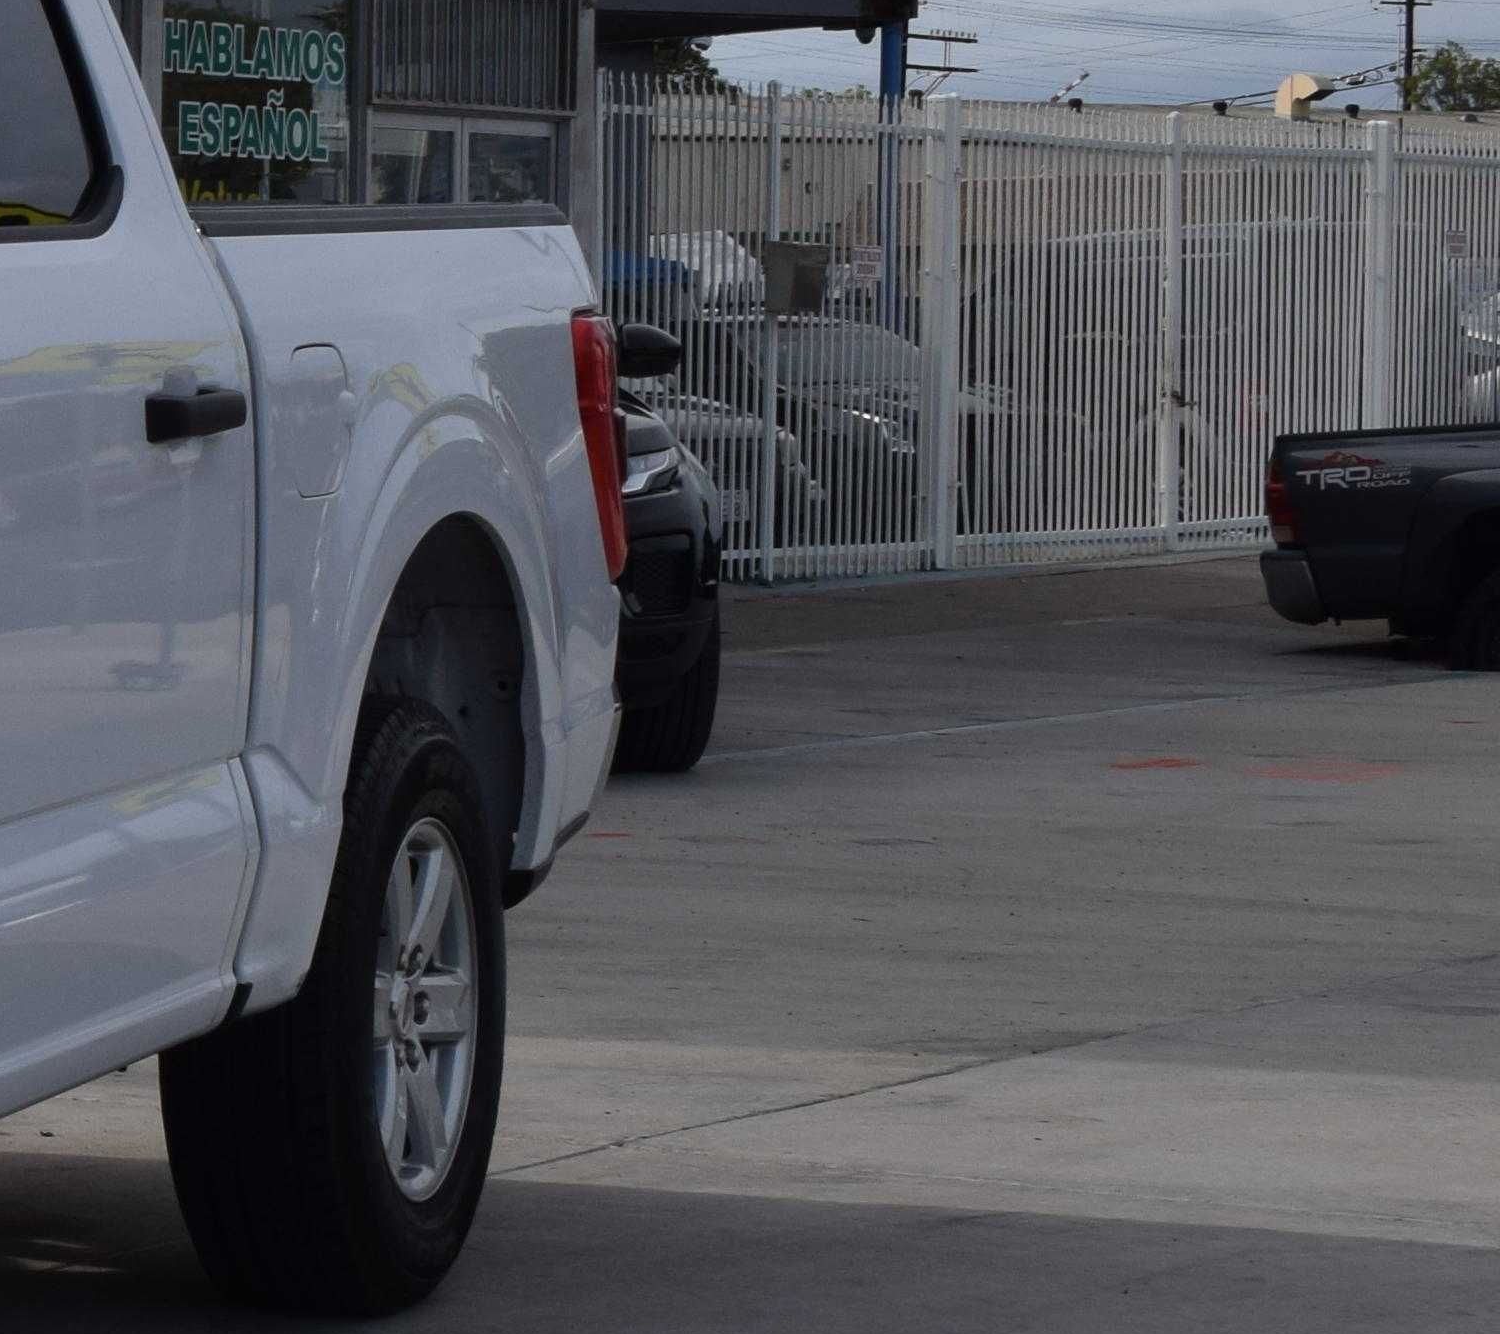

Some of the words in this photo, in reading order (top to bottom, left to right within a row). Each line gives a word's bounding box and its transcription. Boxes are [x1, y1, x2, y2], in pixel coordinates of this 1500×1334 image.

[163, 18, 347, 85] HABLAMOS
[178, 88, 330, 163] ESPAÑOL
[1296, 466, 1371, 491] TRD
